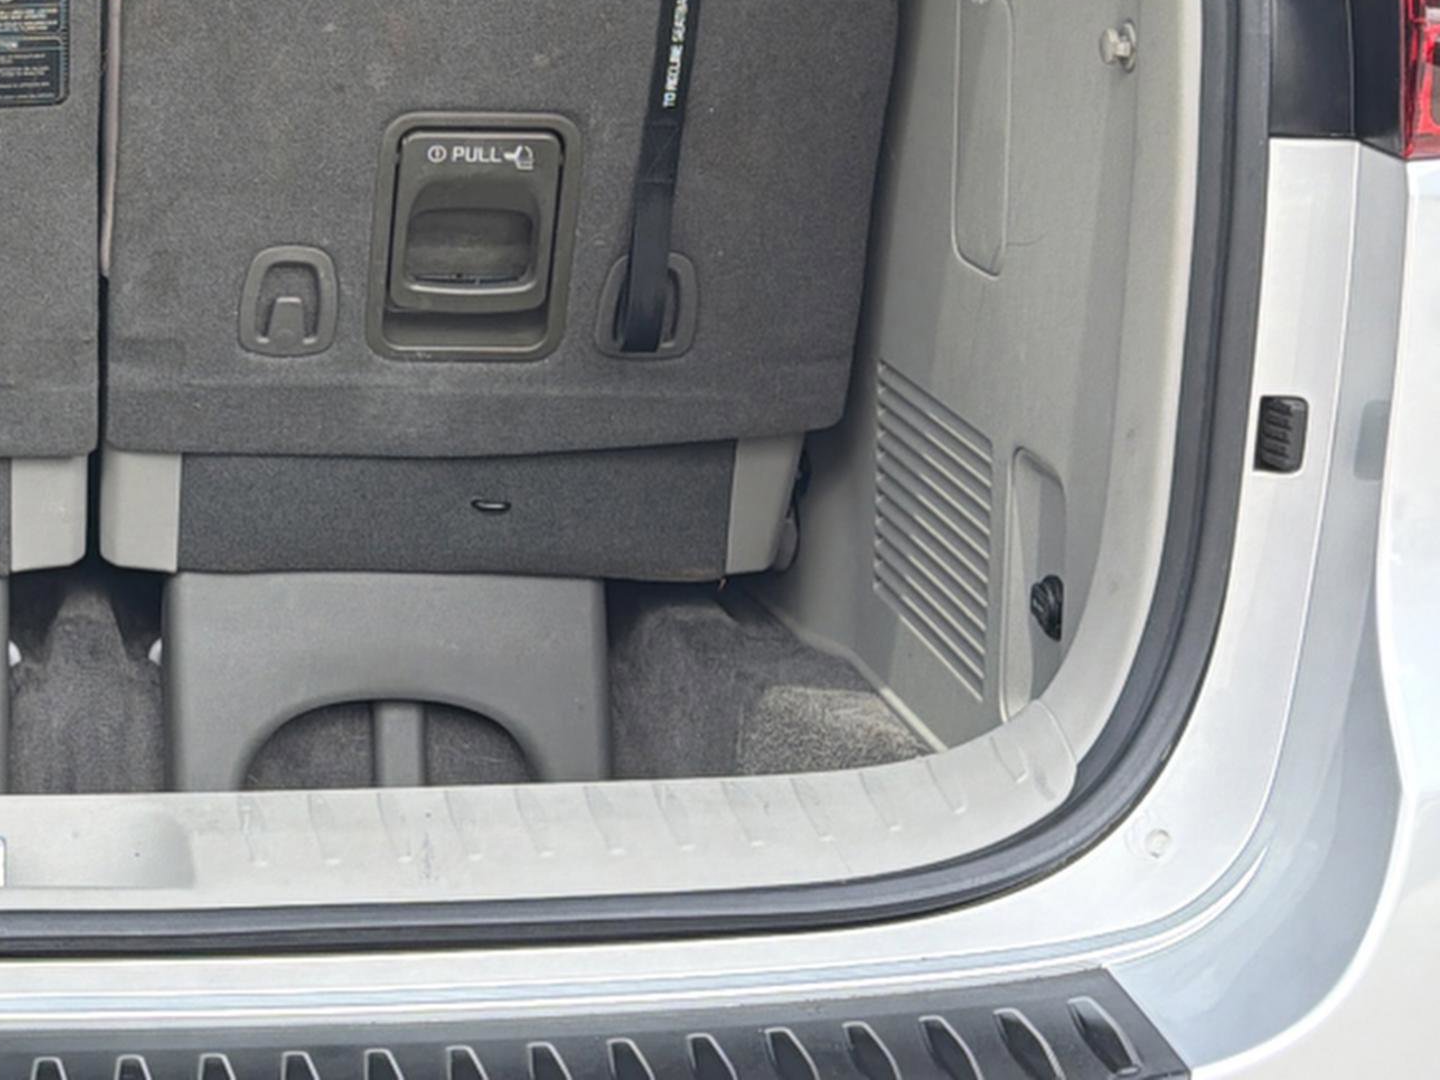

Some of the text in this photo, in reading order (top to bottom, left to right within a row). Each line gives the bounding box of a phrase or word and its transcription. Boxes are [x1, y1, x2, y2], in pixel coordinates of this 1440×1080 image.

[665, 44, 683, 91] RECLINE
[663, 91, 676, 108] TO
[451, 146, 502, 163] PULL
